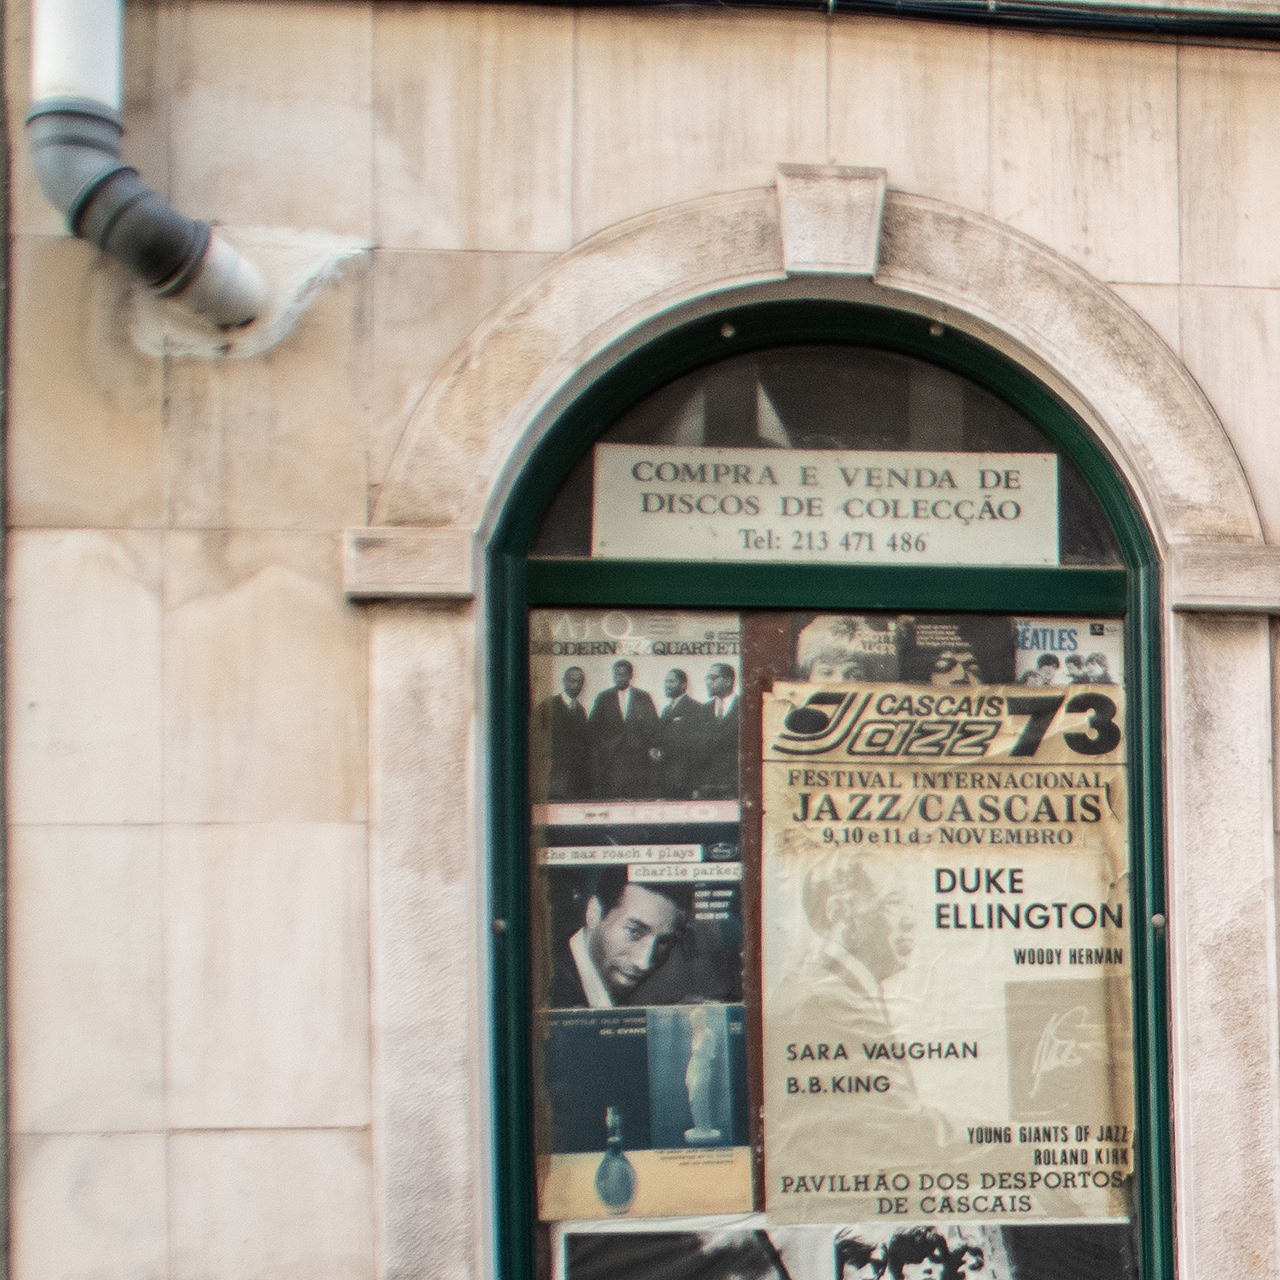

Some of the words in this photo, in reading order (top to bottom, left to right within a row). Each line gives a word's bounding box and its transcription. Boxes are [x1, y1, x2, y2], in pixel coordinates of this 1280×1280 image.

[631, 460, 778, 486] COMPRA
[800, 465, 819, 486] E
[839, 466, 957, 489] VENDA
[978, 469, 1021, 491] DE
[641, 492, 760, 516] DISCOS
[780, 495, 824, 518] DE
[843, 494, 1022, 525] COLECÇÃO
[739, 529, 780, 551] Tel:
[792, 530, 828, 551] 213
[840, 530, 875, 552] 471
[886, 532, 926, 553] 486
[652, 641, 739, 656] QUARTET
[875, 693, 1004, 717] CASCAIS
[1006, 692, 1122, 758] 73
[787, 768, 901, 788] FESTIVAL
[912, 770, 1105, 790] INTERNACIONAL
[791, 792, 1101, 823] JAZZ/CASCAIS
[939, 827, 1073, 846] NOVEMBRO
[571, 849, 596, 860] max
[602, 846, 640, 860] roach
[659, 845, 694, 859] plays
[634, 866, 687, 877] charlie
[693, 864, 739, 879] parker
[935, 868, 1023, 894] DUKE
[935, 902, 1122, 929] ELLINGTON
[1013, 948, 1062, 965] WOODY
[786, 1043, 848, 1061] SARA
[862, 1042, 978, 1060] VAUGHAN
[967, 1126, 1011, 1144] YOUNG
[1019, 1126, 1068, 1143] GIANTS
[1075, 1126, 1090, 1143] OF
[1097, 1125, 1128, 1143] JAZZ
[1034, 1148, 1088, 1166] ROLAND
[1095, 1148, 1128, 1165] KIRK
[781, 1170, 910, 1193] PAVILHÃO
[918, 1173, 970, 1191] DOS
[980, 1171, 1123, 1190] DESPORTOS
[877, 1197, 908, 1214] DE
[919, 1195, 1032, 1213] CASCAIS
